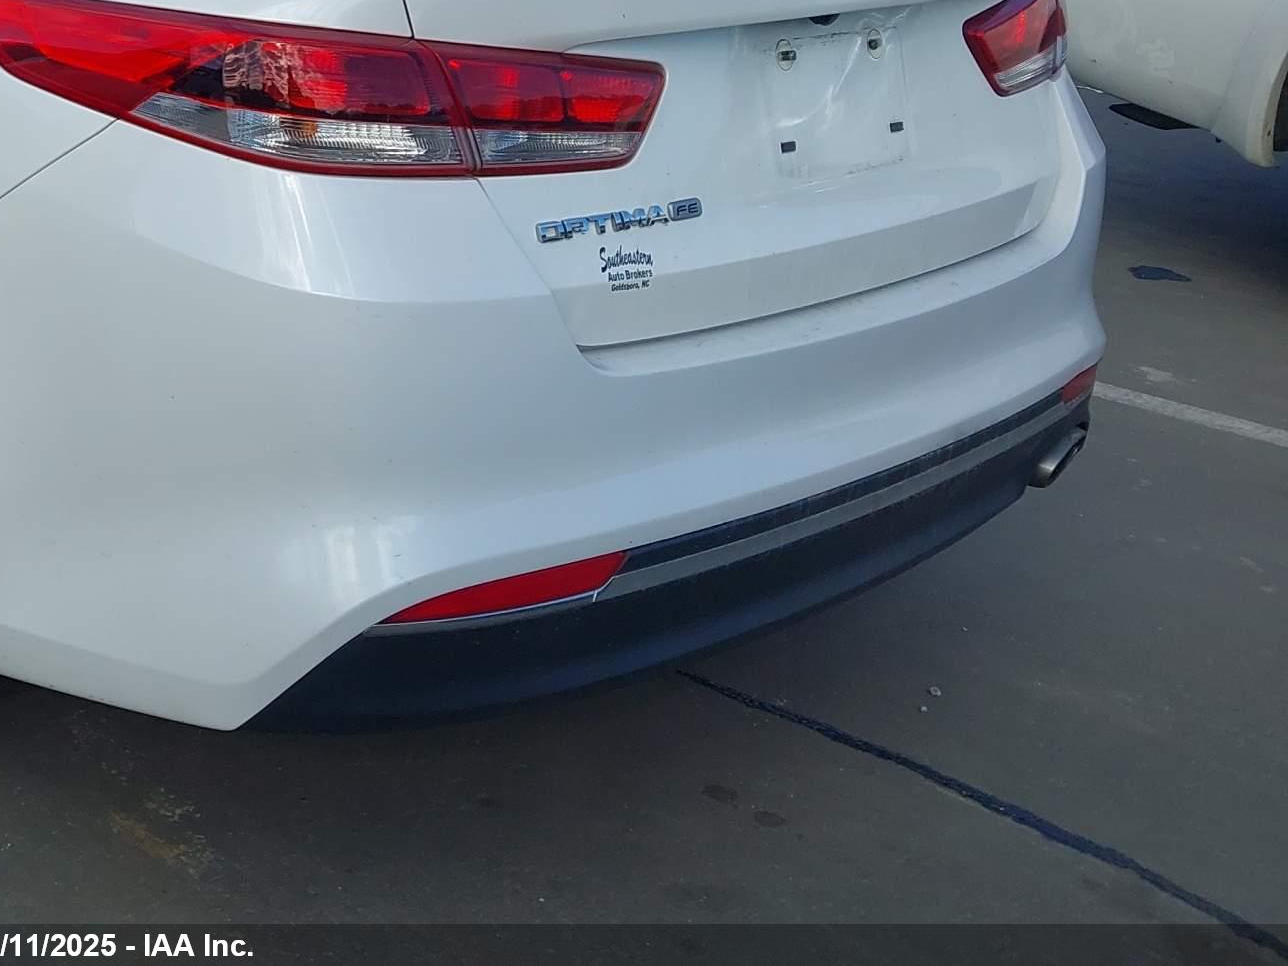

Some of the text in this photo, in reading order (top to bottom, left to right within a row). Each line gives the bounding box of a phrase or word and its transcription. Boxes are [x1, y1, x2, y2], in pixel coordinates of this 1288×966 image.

[536, 204, 669, 243] OPTIMA
[599, 244, 654, 273] Southeastern
[608, 268, 653, 283] Auto Brokers
